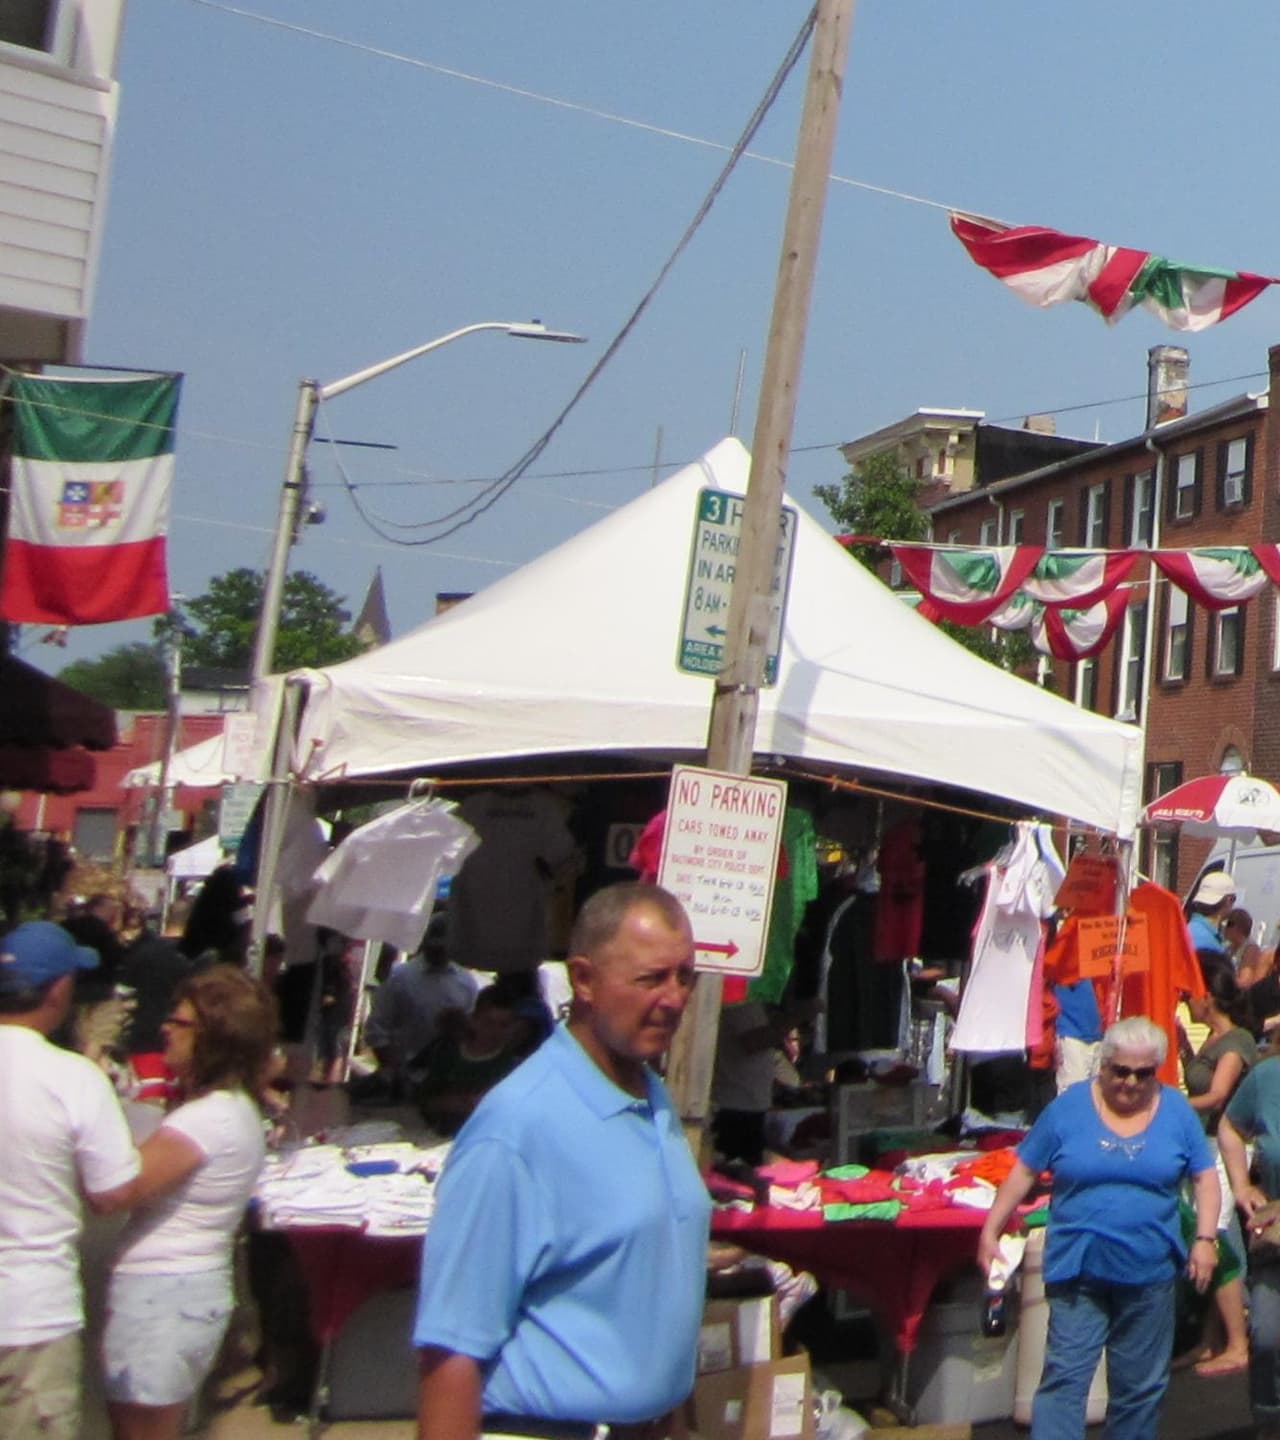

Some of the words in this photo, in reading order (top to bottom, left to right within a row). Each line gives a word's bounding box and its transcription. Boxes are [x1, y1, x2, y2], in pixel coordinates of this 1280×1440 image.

[706, 495, 721, 521] 3
[702, 529, 741, 557] PARKI
[697, 560, 712, 579] IN
[714, 563, 737, 583] AR
[678, 779, 700, 806] NO
[711, 784, 778, 818] PARKING
[679, 819, 702, 835] CARS
[709, 823, 739, 841] TOWED
[743, 829, 769, 842] AWAY
